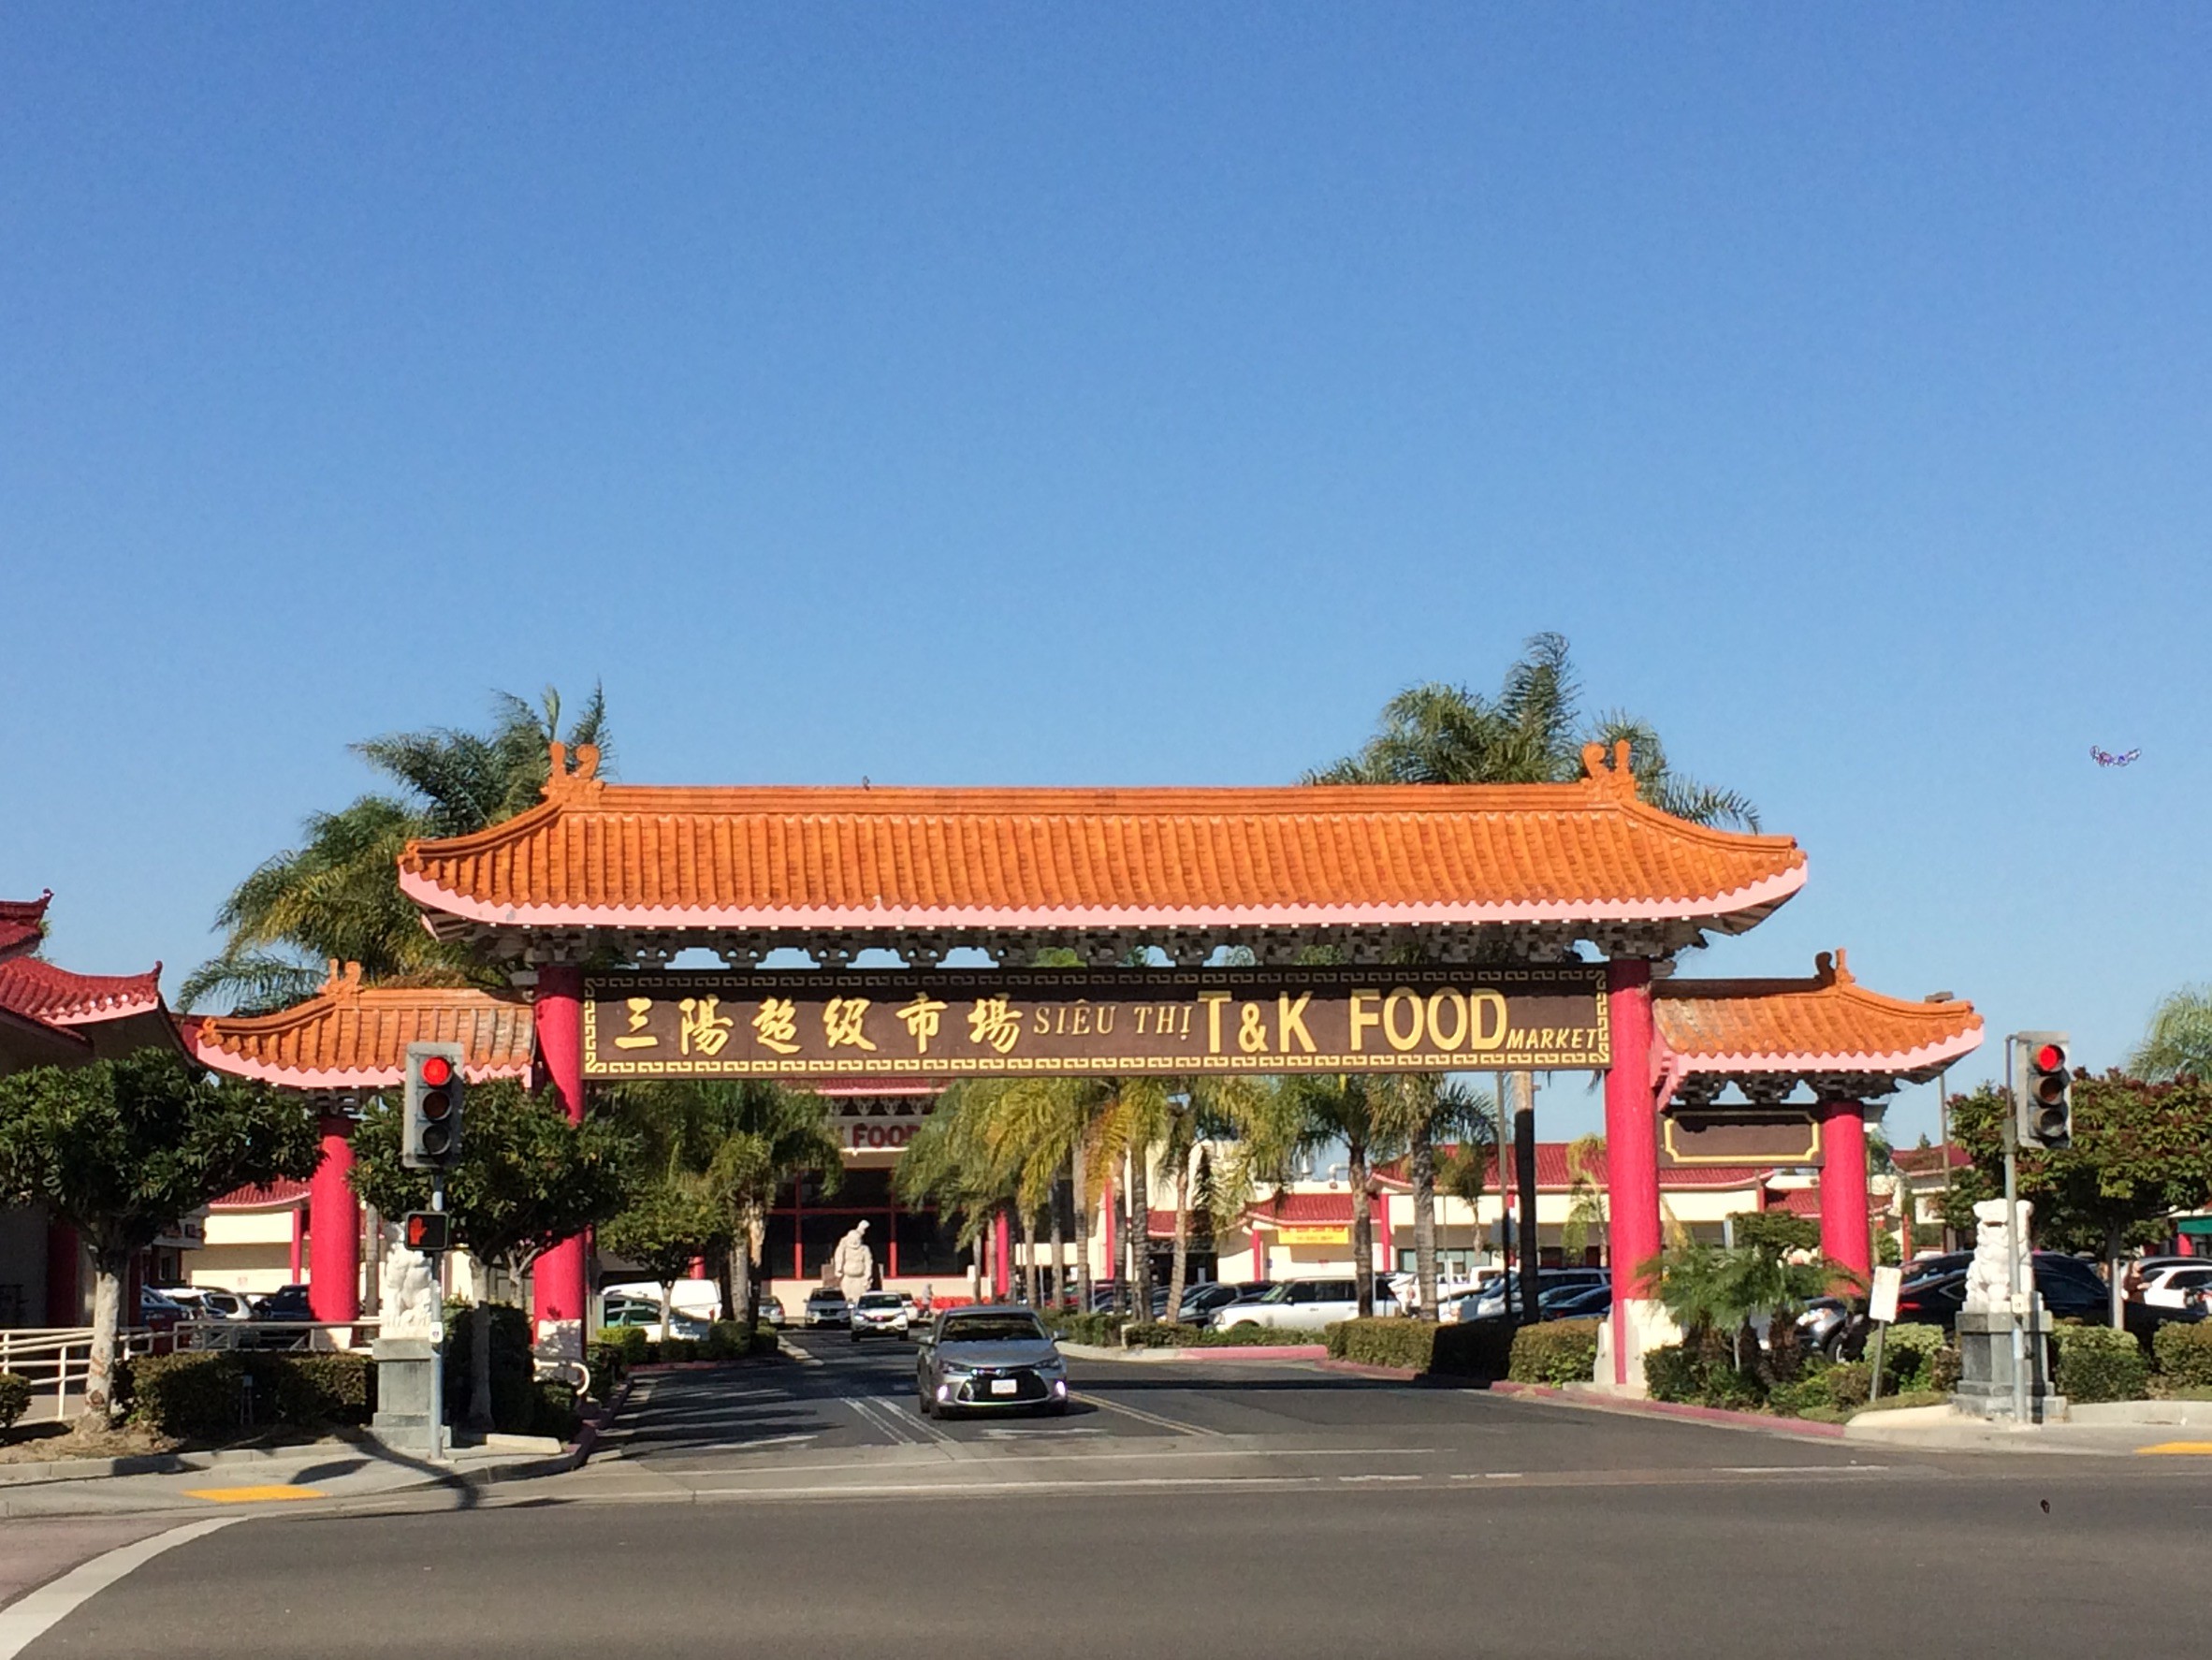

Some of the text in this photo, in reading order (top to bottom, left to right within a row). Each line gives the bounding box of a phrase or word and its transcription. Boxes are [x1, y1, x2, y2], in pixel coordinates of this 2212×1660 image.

[1033, 998, 1116, 1035] SIÊU
[1198, 986, 1599, 1054] T&K FOOD MARKET
